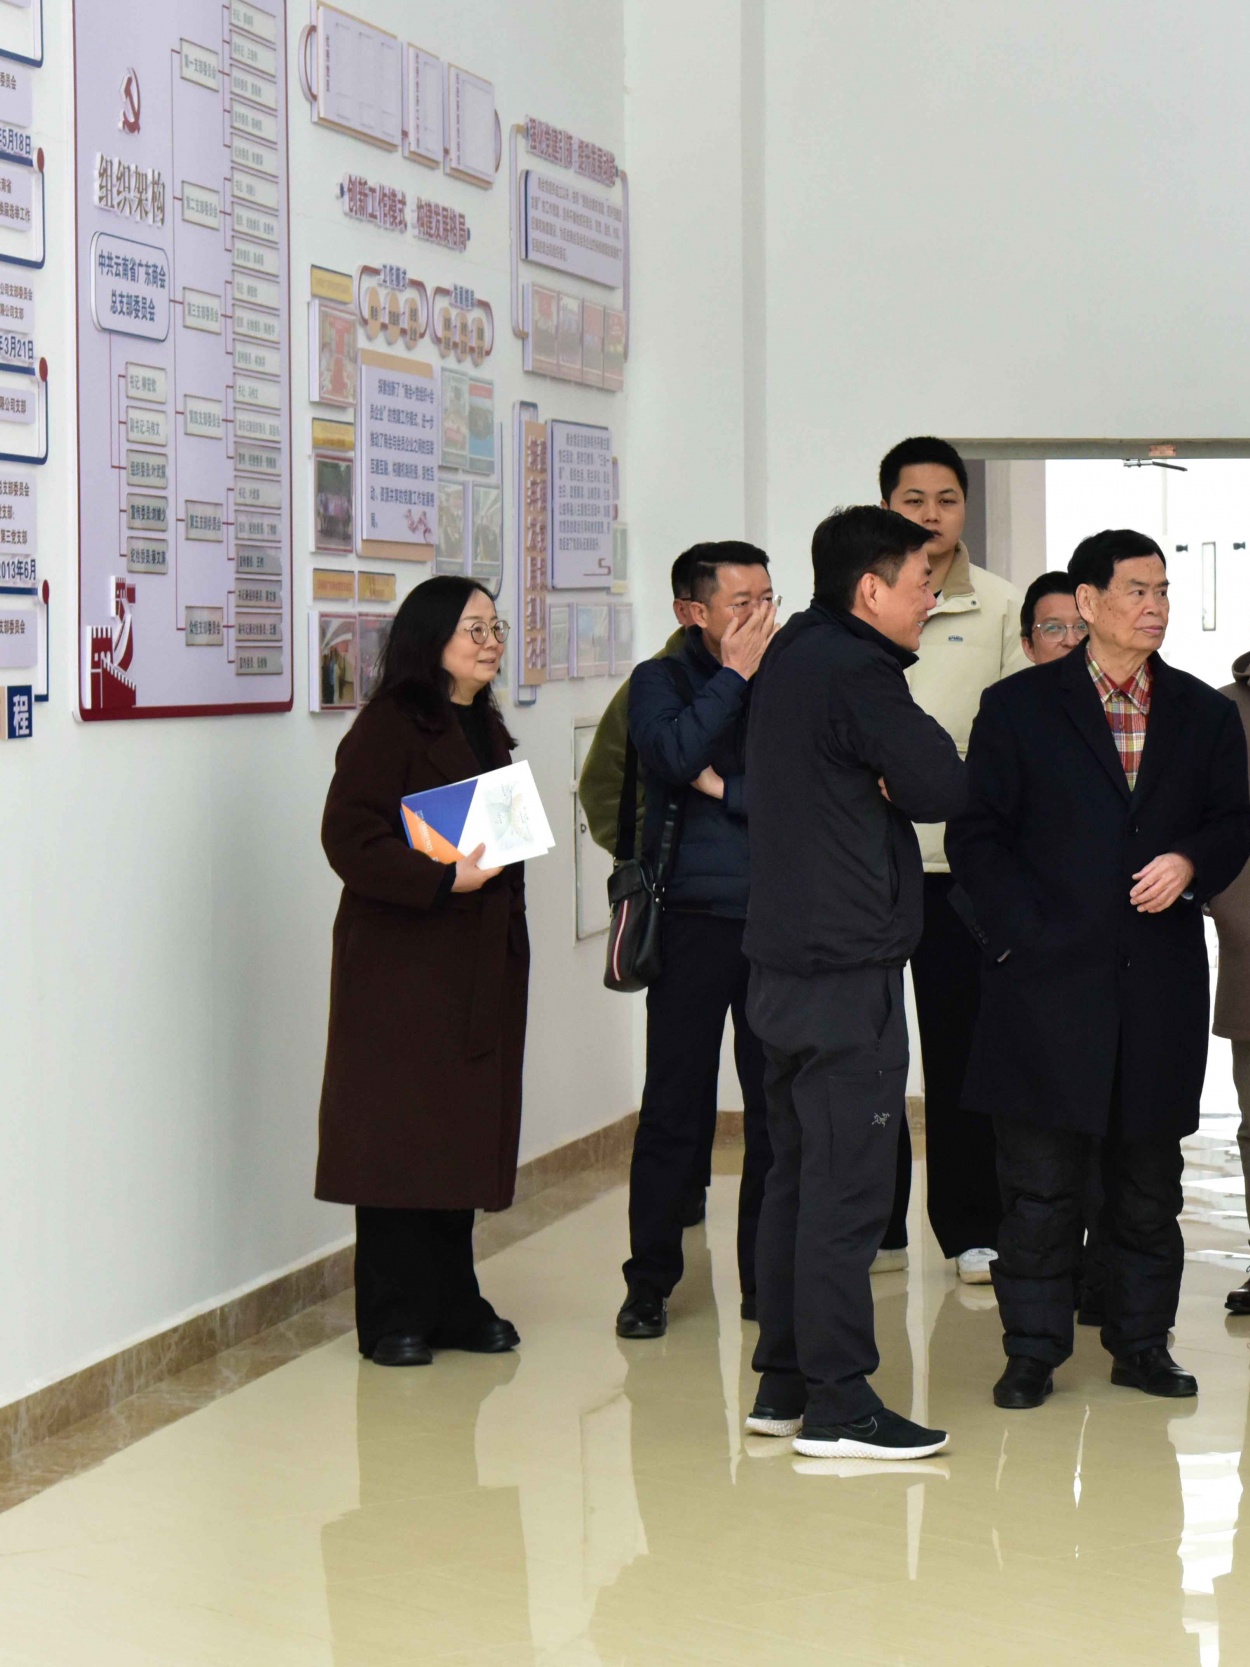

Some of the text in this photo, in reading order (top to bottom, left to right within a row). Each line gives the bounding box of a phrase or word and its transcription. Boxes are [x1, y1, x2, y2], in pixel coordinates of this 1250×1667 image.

[97, 152, 166, 227] 组织架构
[347, 173, 408, 233] 创新工作模式
[98, 249, 167, 290] 中共云南省广东商会
[110, 289, 156, 323] 总支部委员会
[0, 558, 37, 581] 013年6月
[12, 693, 31, 737] 程
